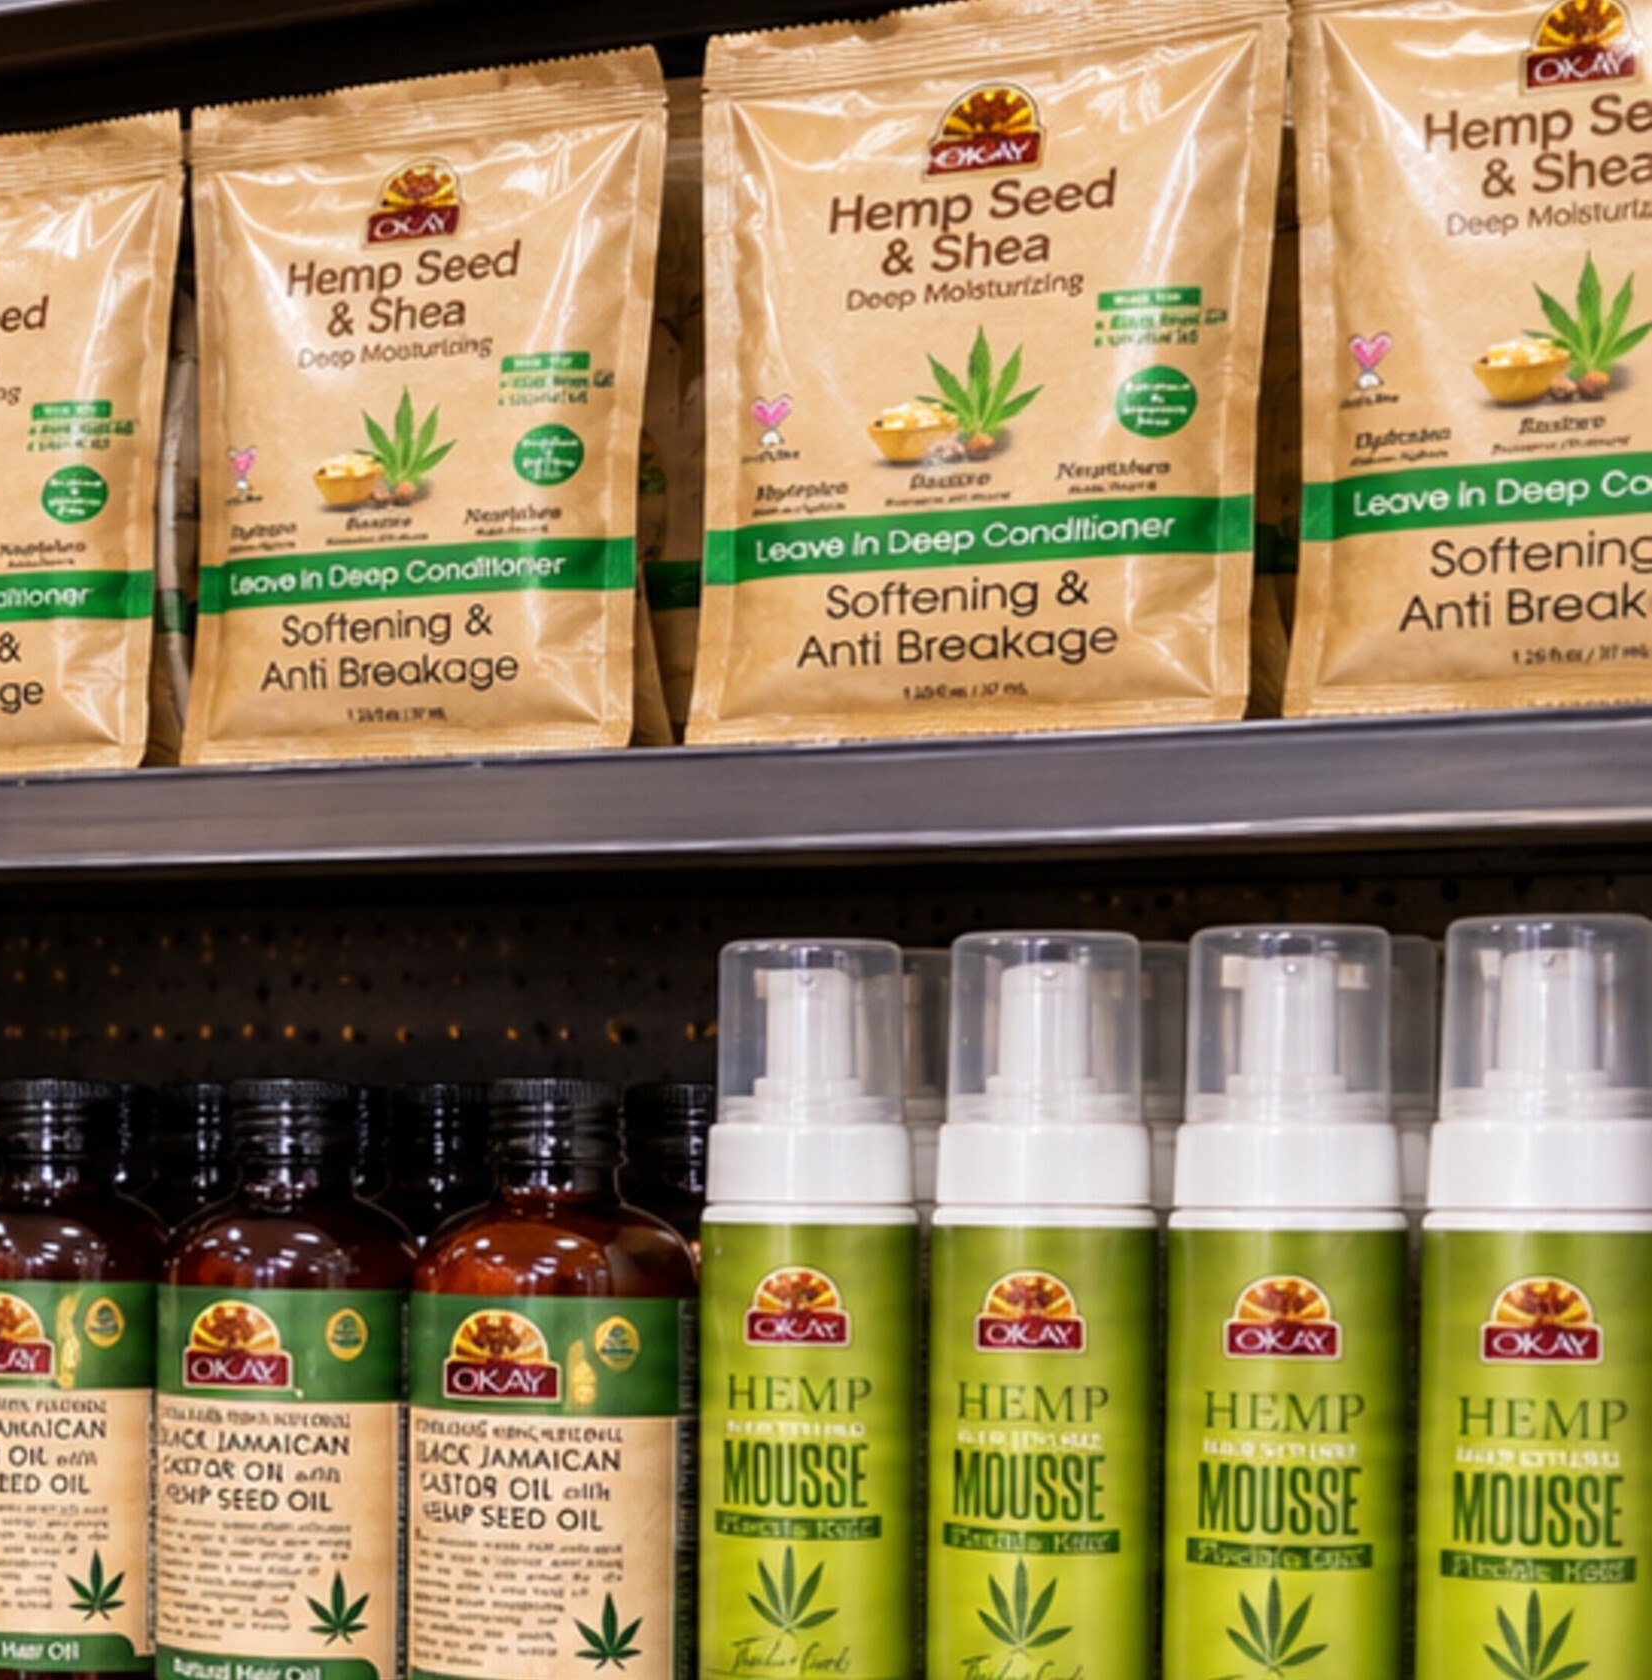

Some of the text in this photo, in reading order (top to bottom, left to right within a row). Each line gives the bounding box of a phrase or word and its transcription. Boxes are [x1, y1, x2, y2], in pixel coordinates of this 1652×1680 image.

[1534, 52, 1630, 83] OKAY
[1424, 108, 1574, 152] Hemp
[936, 141, 1029, 169] OKAY
[1482, 150, 1652, 198] & Shea
[828, 169, 1117, 235] Hemp Seed
[1446, 212, 1519, 237] Deep
[287, 240, 521, 297] Hemp Seed
[881, 233, 1051, 277] & Shea
[846, 272, 1085, 312] Deep Moisturizing
[327, 297, 465, 337] & Shea
[1353, 489, 1450, 518] Leave
[1457, 481, 1485, 508] in
[1496, 478, 1590, 506] Deep
[755, 513, 1176, 563] Leave in Deep Conditioner
[230, 557, 566, 596] Leave in Deep Conditioner
[826, 570, 1089, 620] Softening &
[282, 604, 492, 647] Softening &
[1398, 592, 1491, 632] Anti
[797, 623, 1118, 669] Anti Breakage
[261, 654, 518, 692] Anti Breakage
[753, 1319, 839, 1340] OKAY
[986, 1322, 1074, 1346] OKAY
[1235, 1328, 1329, 1352] OKAY
[1492, 1331, 1588, 1357] OKAY
[193, 1357, 277, 1383] OKAY
[453, 1368, 545, 1393] OKAY
[728, 1373, 873, 1413] HEMP
[957, 1381, 1109, 1422] HEMP
[1204, 1391, 1366, 1434] HEMP
[1457, 1396, 1629, 1441] HEMP
[9, 1446, 47, 1466] OIL
[217, 1431, 350, 1456] JAMAICAN
[480, 1446, 621, 1471] JAMAICAN
[50, 1474, 89, 1494] OIL
[510, 1477, 552, 1500] OIL
[723, 1440, 868, 1507] MOUSSE
[953, 1449, 1105, 1522] MOUSSE
[218, 1488, 332, 1512] SEED OIL
[481, 1505, 546, 1529] SEED
[557, 1508, 603, 1531] OIL
[1198, 1462, 1362, 1536] MOUSSE
[1452, 1471, 1623, 1549] MOUSSE
